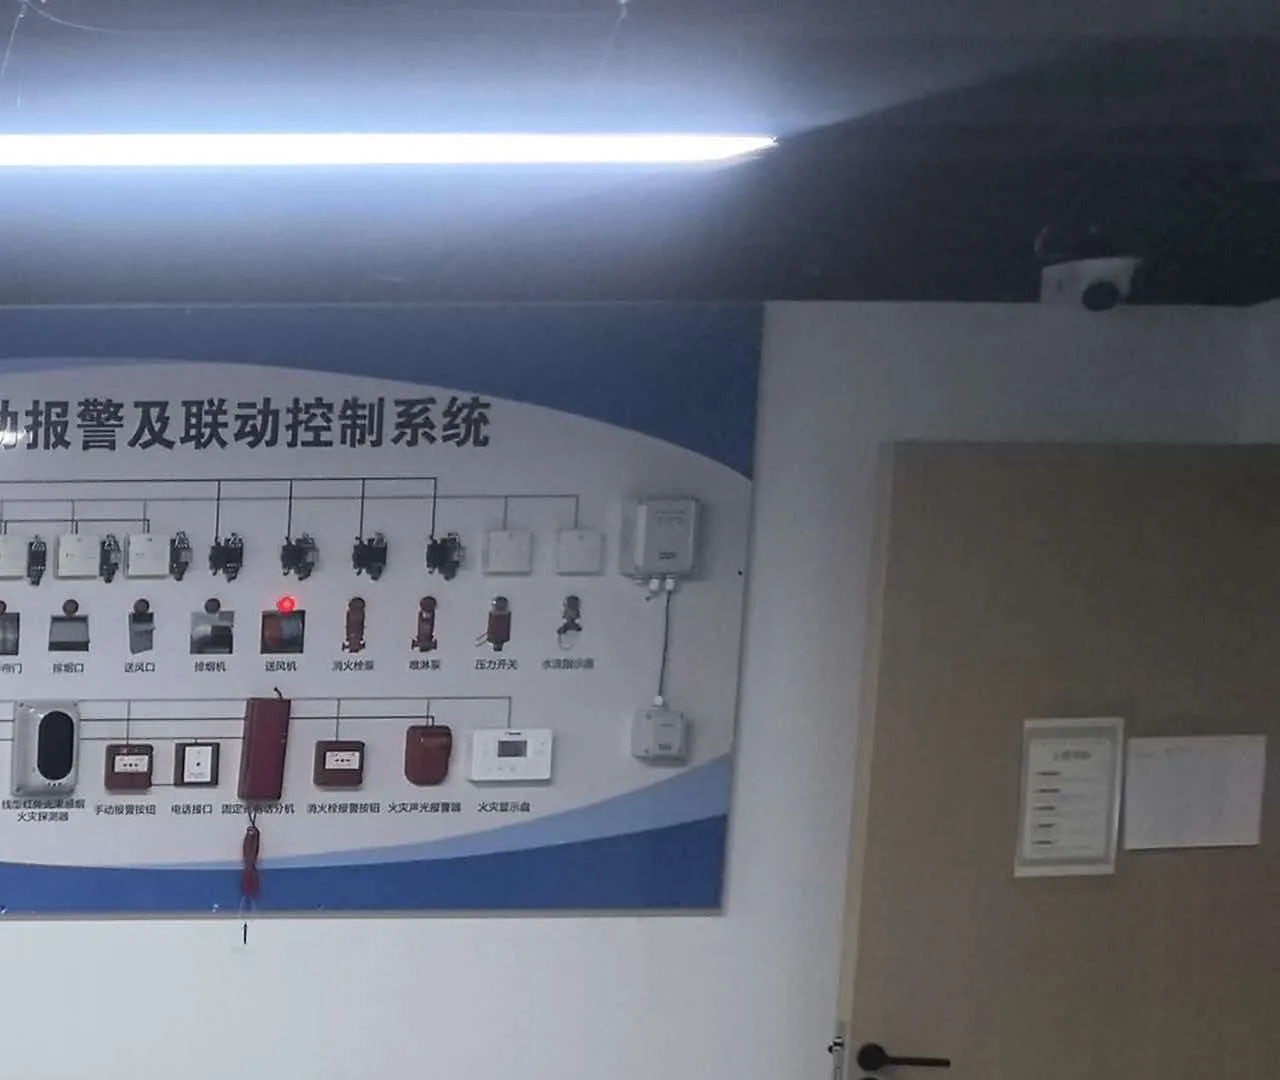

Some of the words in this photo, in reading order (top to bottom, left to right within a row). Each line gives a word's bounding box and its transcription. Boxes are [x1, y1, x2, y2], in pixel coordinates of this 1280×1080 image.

[264, 660, 297, 672] 送风机
[474, 659, 519, 671] 压力开关
